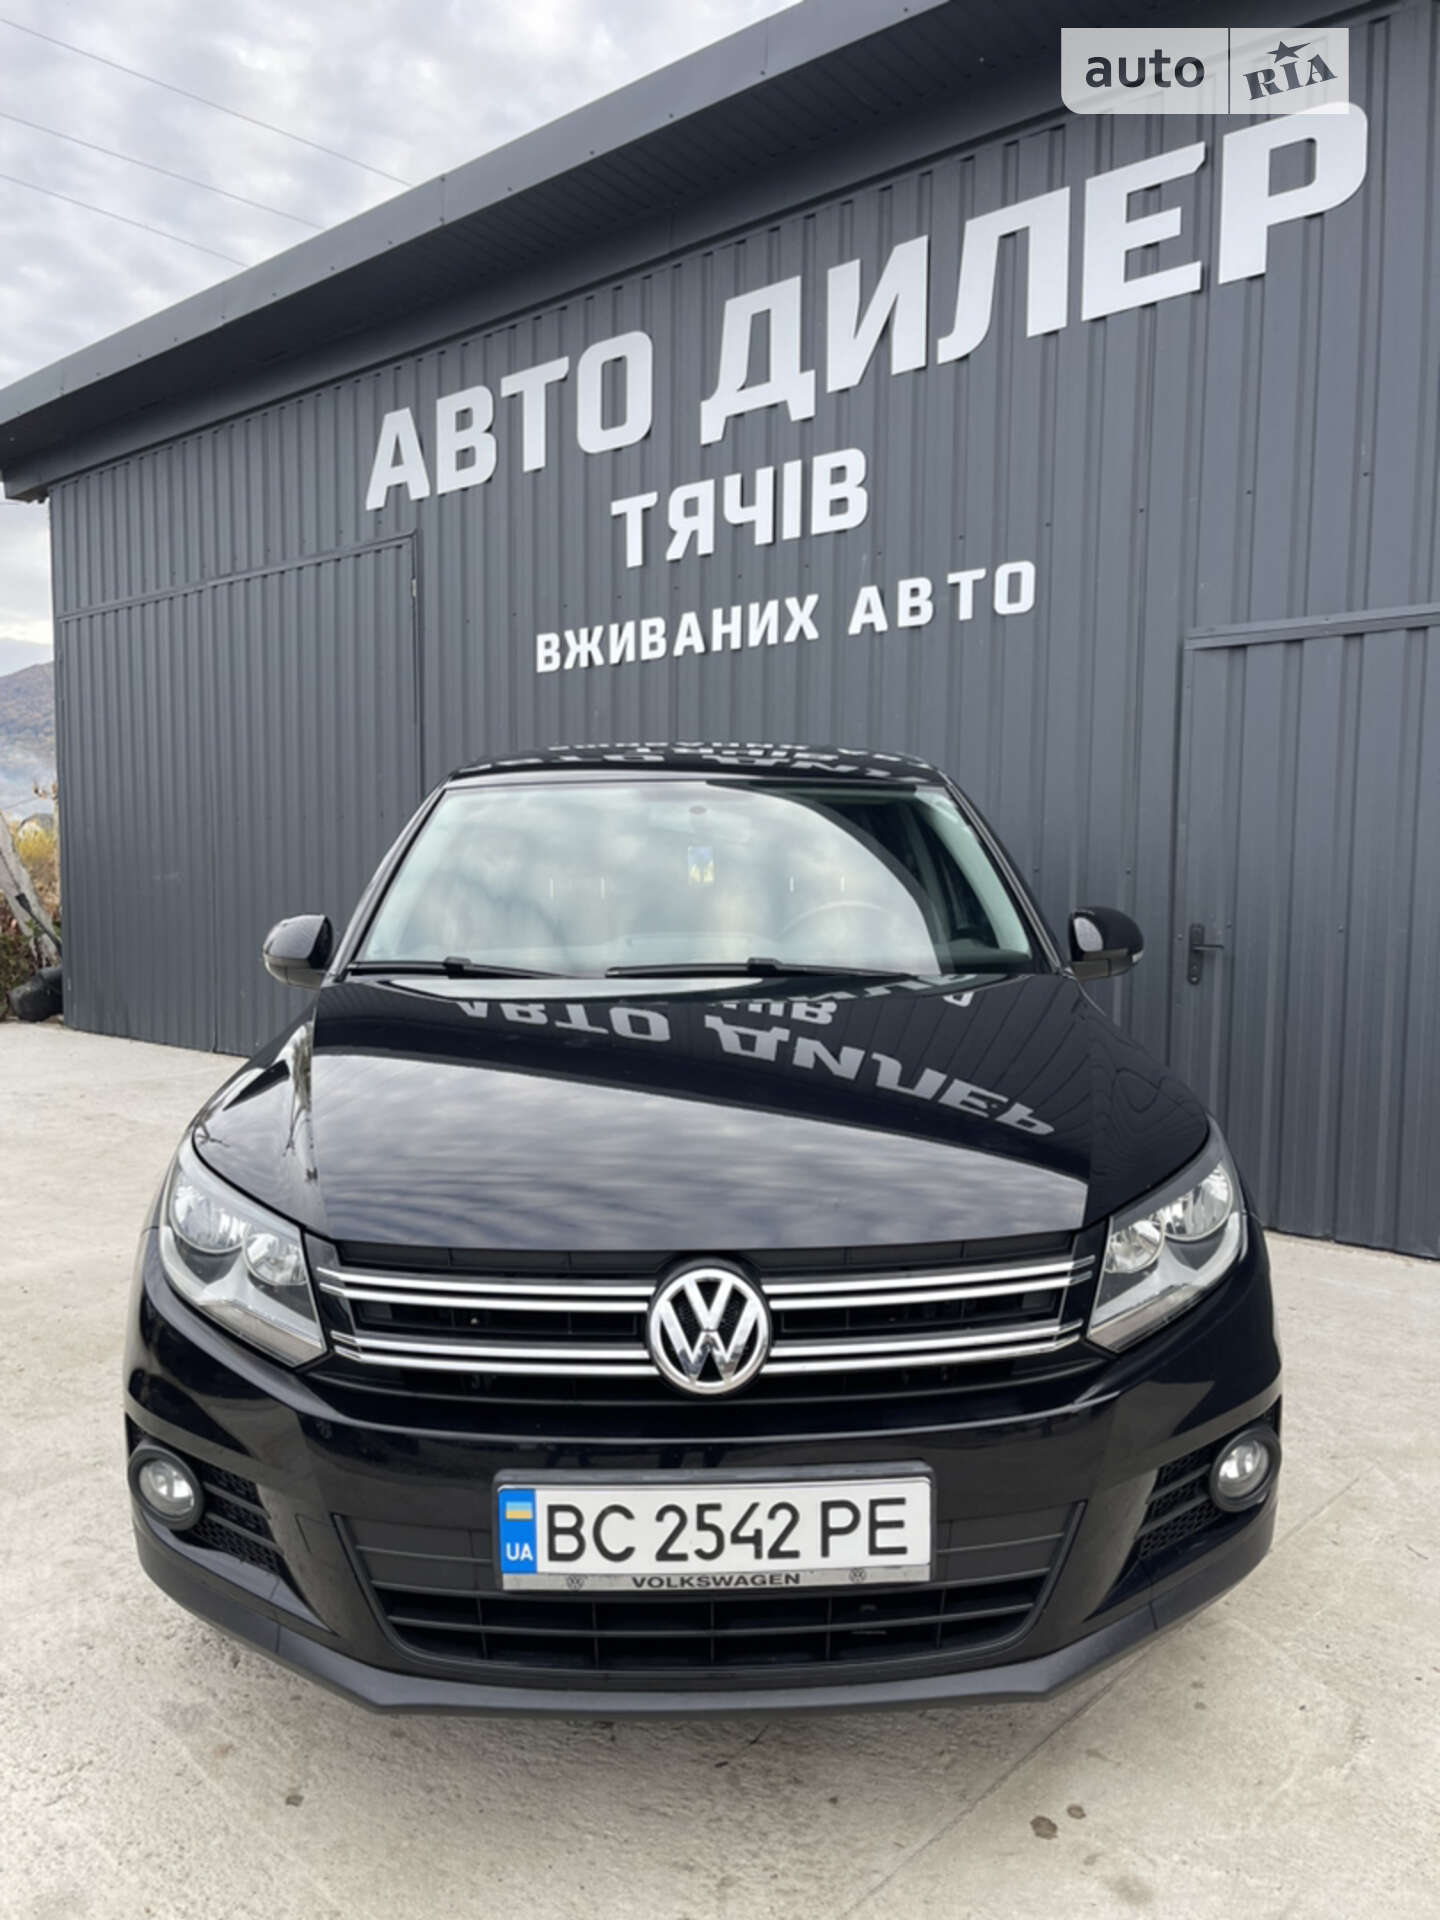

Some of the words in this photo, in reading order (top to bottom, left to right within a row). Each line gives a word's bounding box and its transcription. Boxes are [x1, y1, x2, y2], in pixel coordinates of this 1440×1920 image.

[365, 331, 653, 511] АВТО
[700, 104, 1368, 445] ДИЛЕР
[610, 447, 869, 568] ТЯЧІВ
[536, 593, 819, 673] ВЖИВАНИХ
[848, 560, 1036, 636] АВТО
[505, 1543, 534, 1562] UA
[546, 1504, 636, 1563] BC
[655, 1501, 801, 1562] 2542
[820, 1497, 909, 1558] PE
[631, 1572, 801, 1590] VOLKSWAGEN
